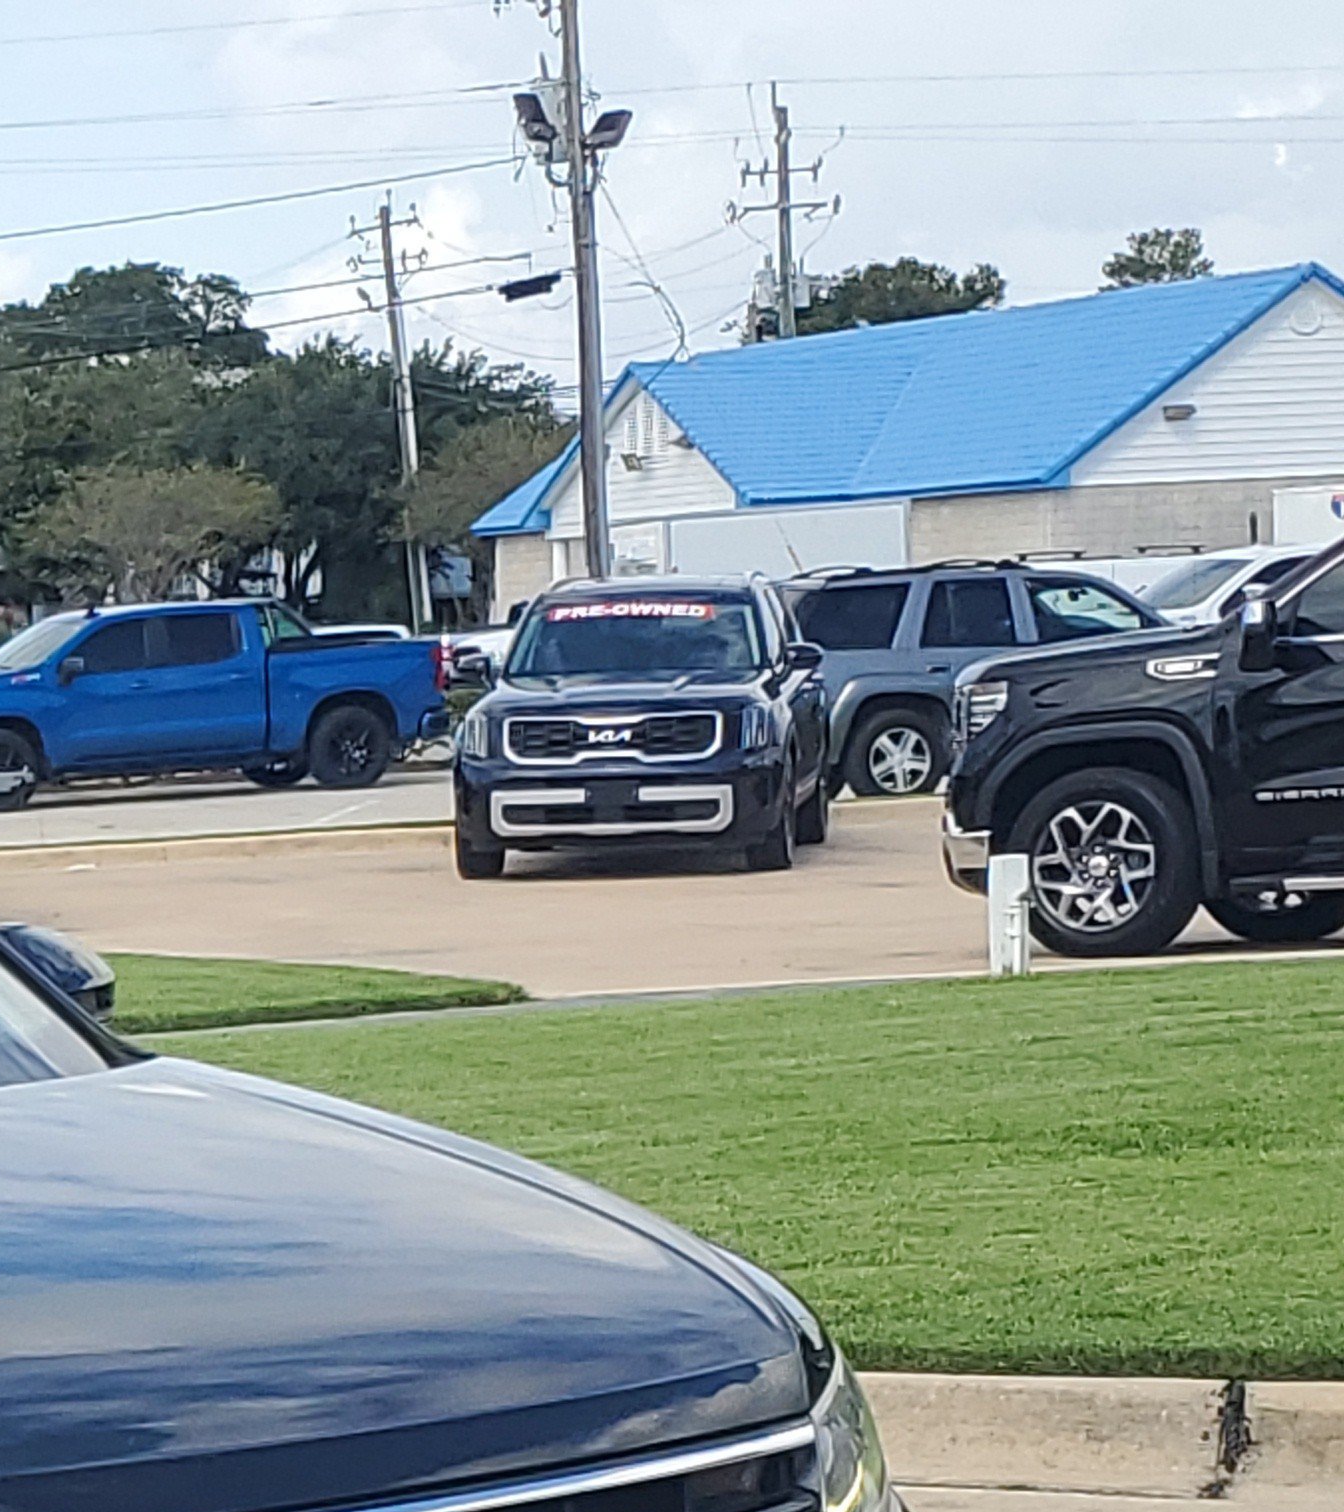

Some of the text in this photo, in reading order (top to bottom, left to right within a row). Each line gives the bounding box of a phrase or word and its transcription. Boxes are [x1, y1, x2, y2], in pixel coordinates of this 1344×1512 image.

[554, 602, 706, 620] PRE-OWNED
[588, 729, 633, 743] KIA
[1255, 787, 1344, 802] SIERR
